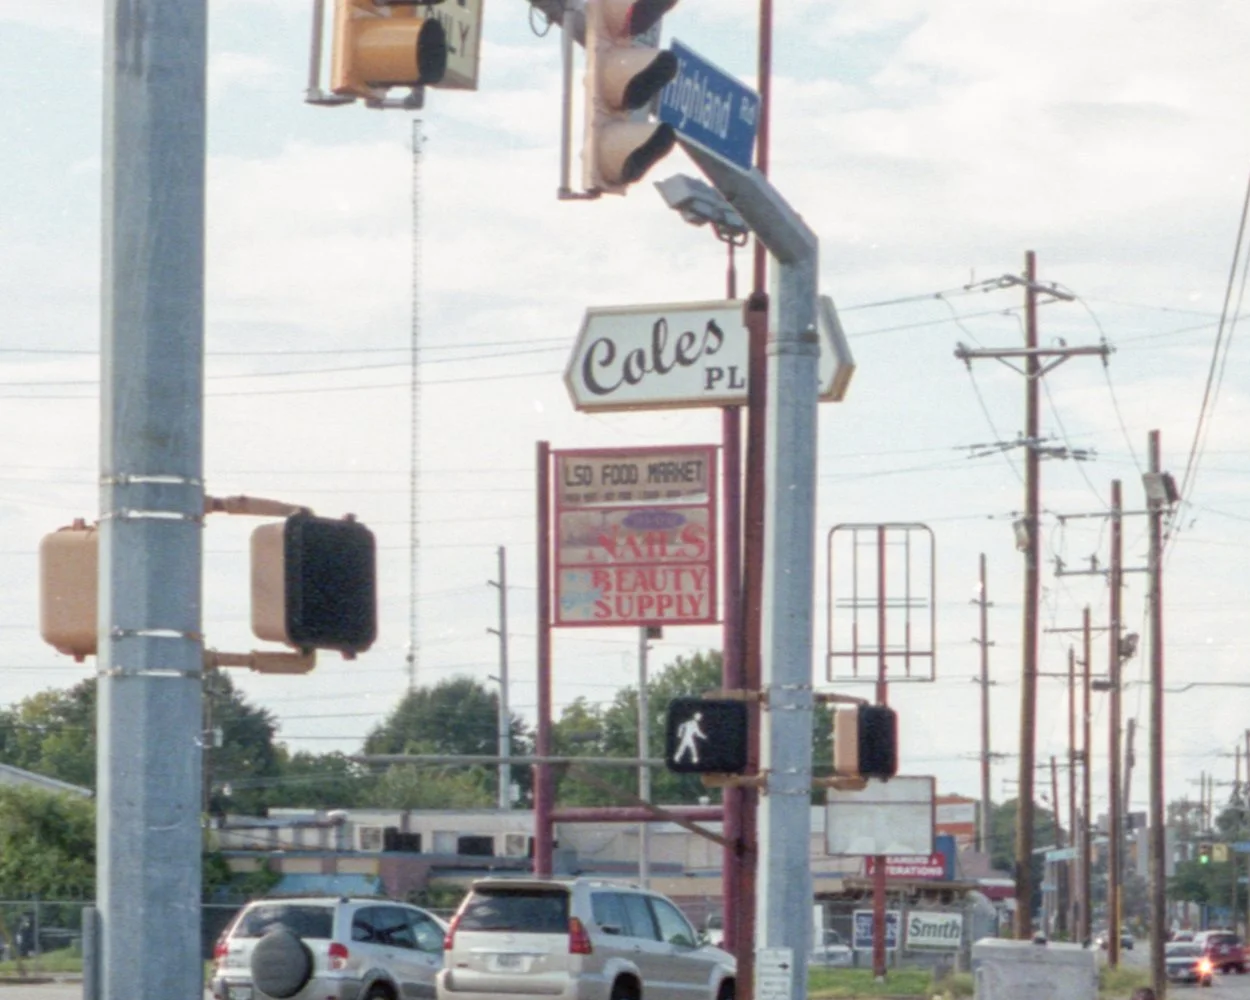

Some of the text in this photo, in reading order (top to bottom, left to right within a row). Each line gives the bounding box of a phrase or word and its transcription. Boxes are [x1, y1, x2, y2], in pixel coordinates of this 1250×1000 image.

[582, 317, 724, 396] Coles
[601, 463, 638, 486] FOOD
[647, 460, 703, 483] MARKET
[585, 523, 706, 562] NAILS
[592, 568, 705, 592] BEAUTY
[594, 593, 704, 618] SUPPLY
